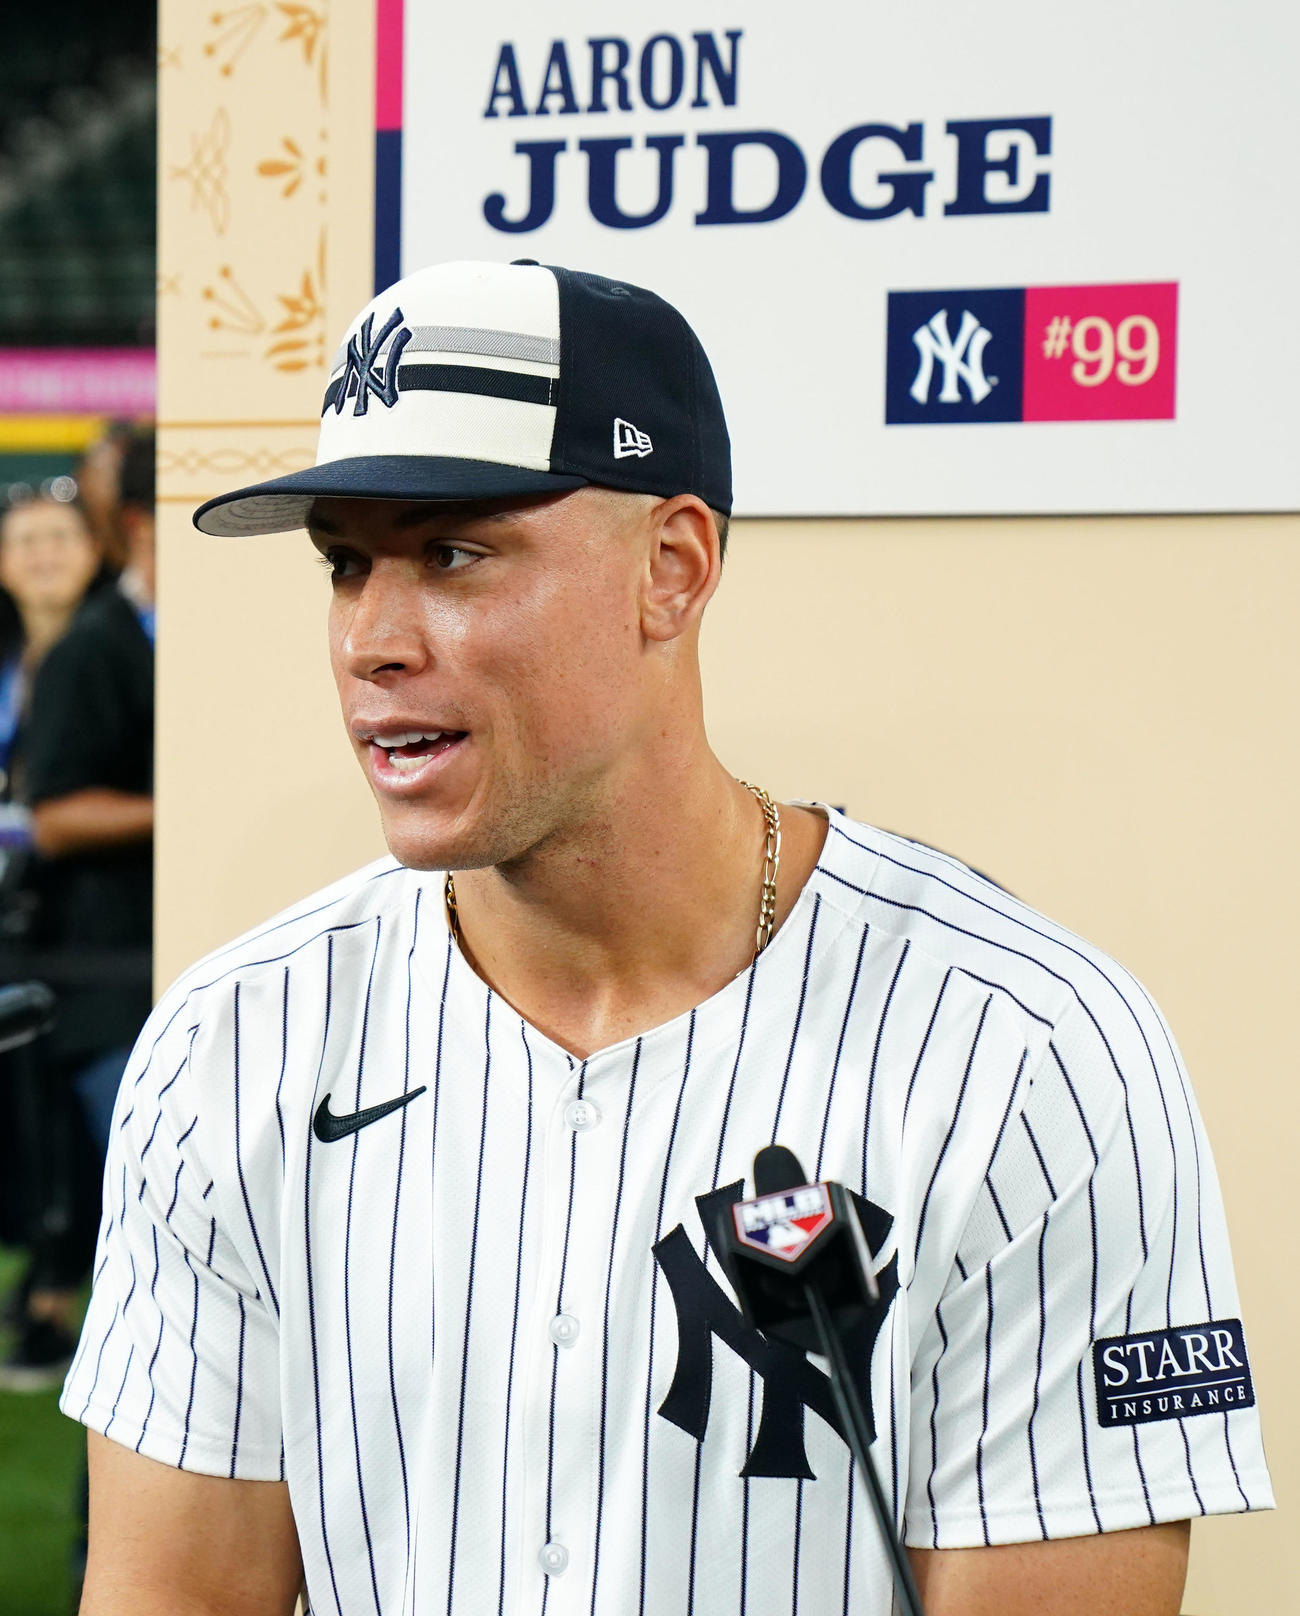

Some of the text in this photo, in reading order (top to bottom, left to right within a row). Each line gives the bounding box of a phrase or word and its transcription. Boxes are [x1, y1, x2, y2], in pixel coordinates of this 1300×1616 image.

[484, 28, 743, 118] AARON
[482, 115, 1053, 233] JUDGE
[334, 306, 413, 417] NY
[909, 308, 1161, 405] NY #99
[1103, 1329, 1244, 1387] STARR
[1110, 1385, 1246, 1419] INSURANCE
